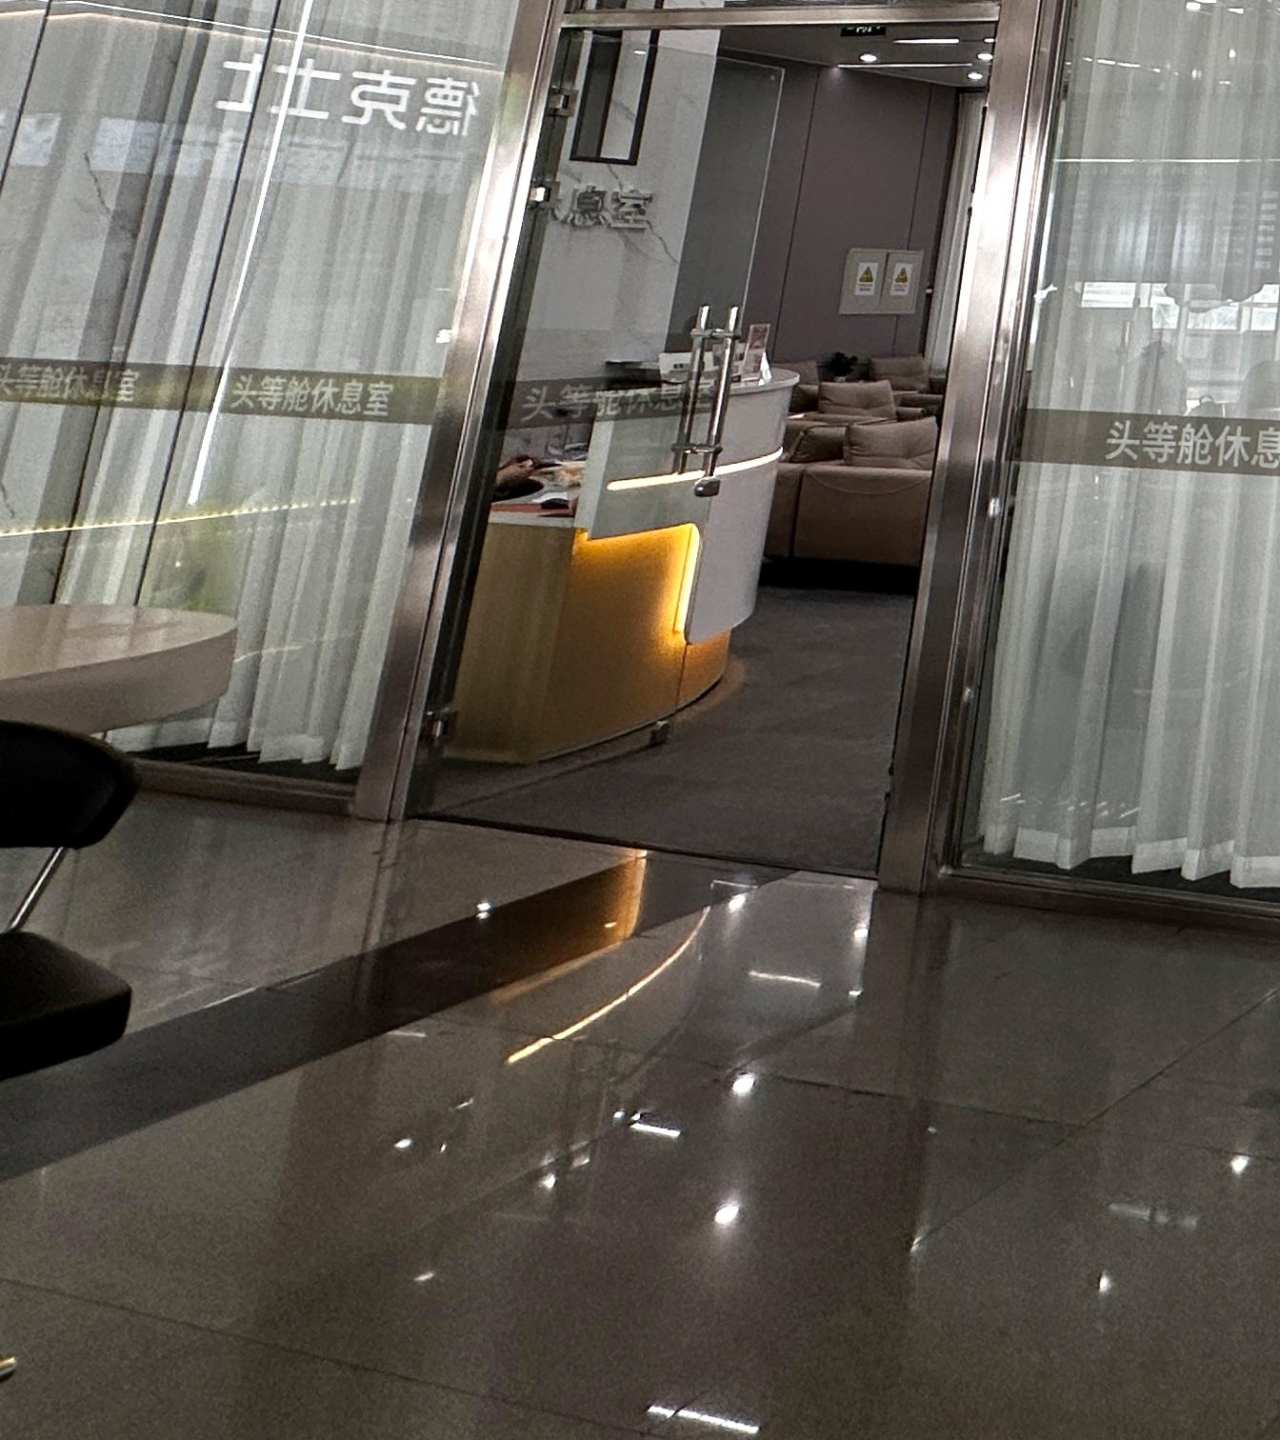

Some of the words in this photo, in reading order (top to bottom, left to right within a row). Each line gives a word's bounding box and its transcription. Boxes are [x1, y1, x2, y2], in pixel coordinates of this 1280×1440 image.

[230, 373, 394, 418] 头等舱休息室
